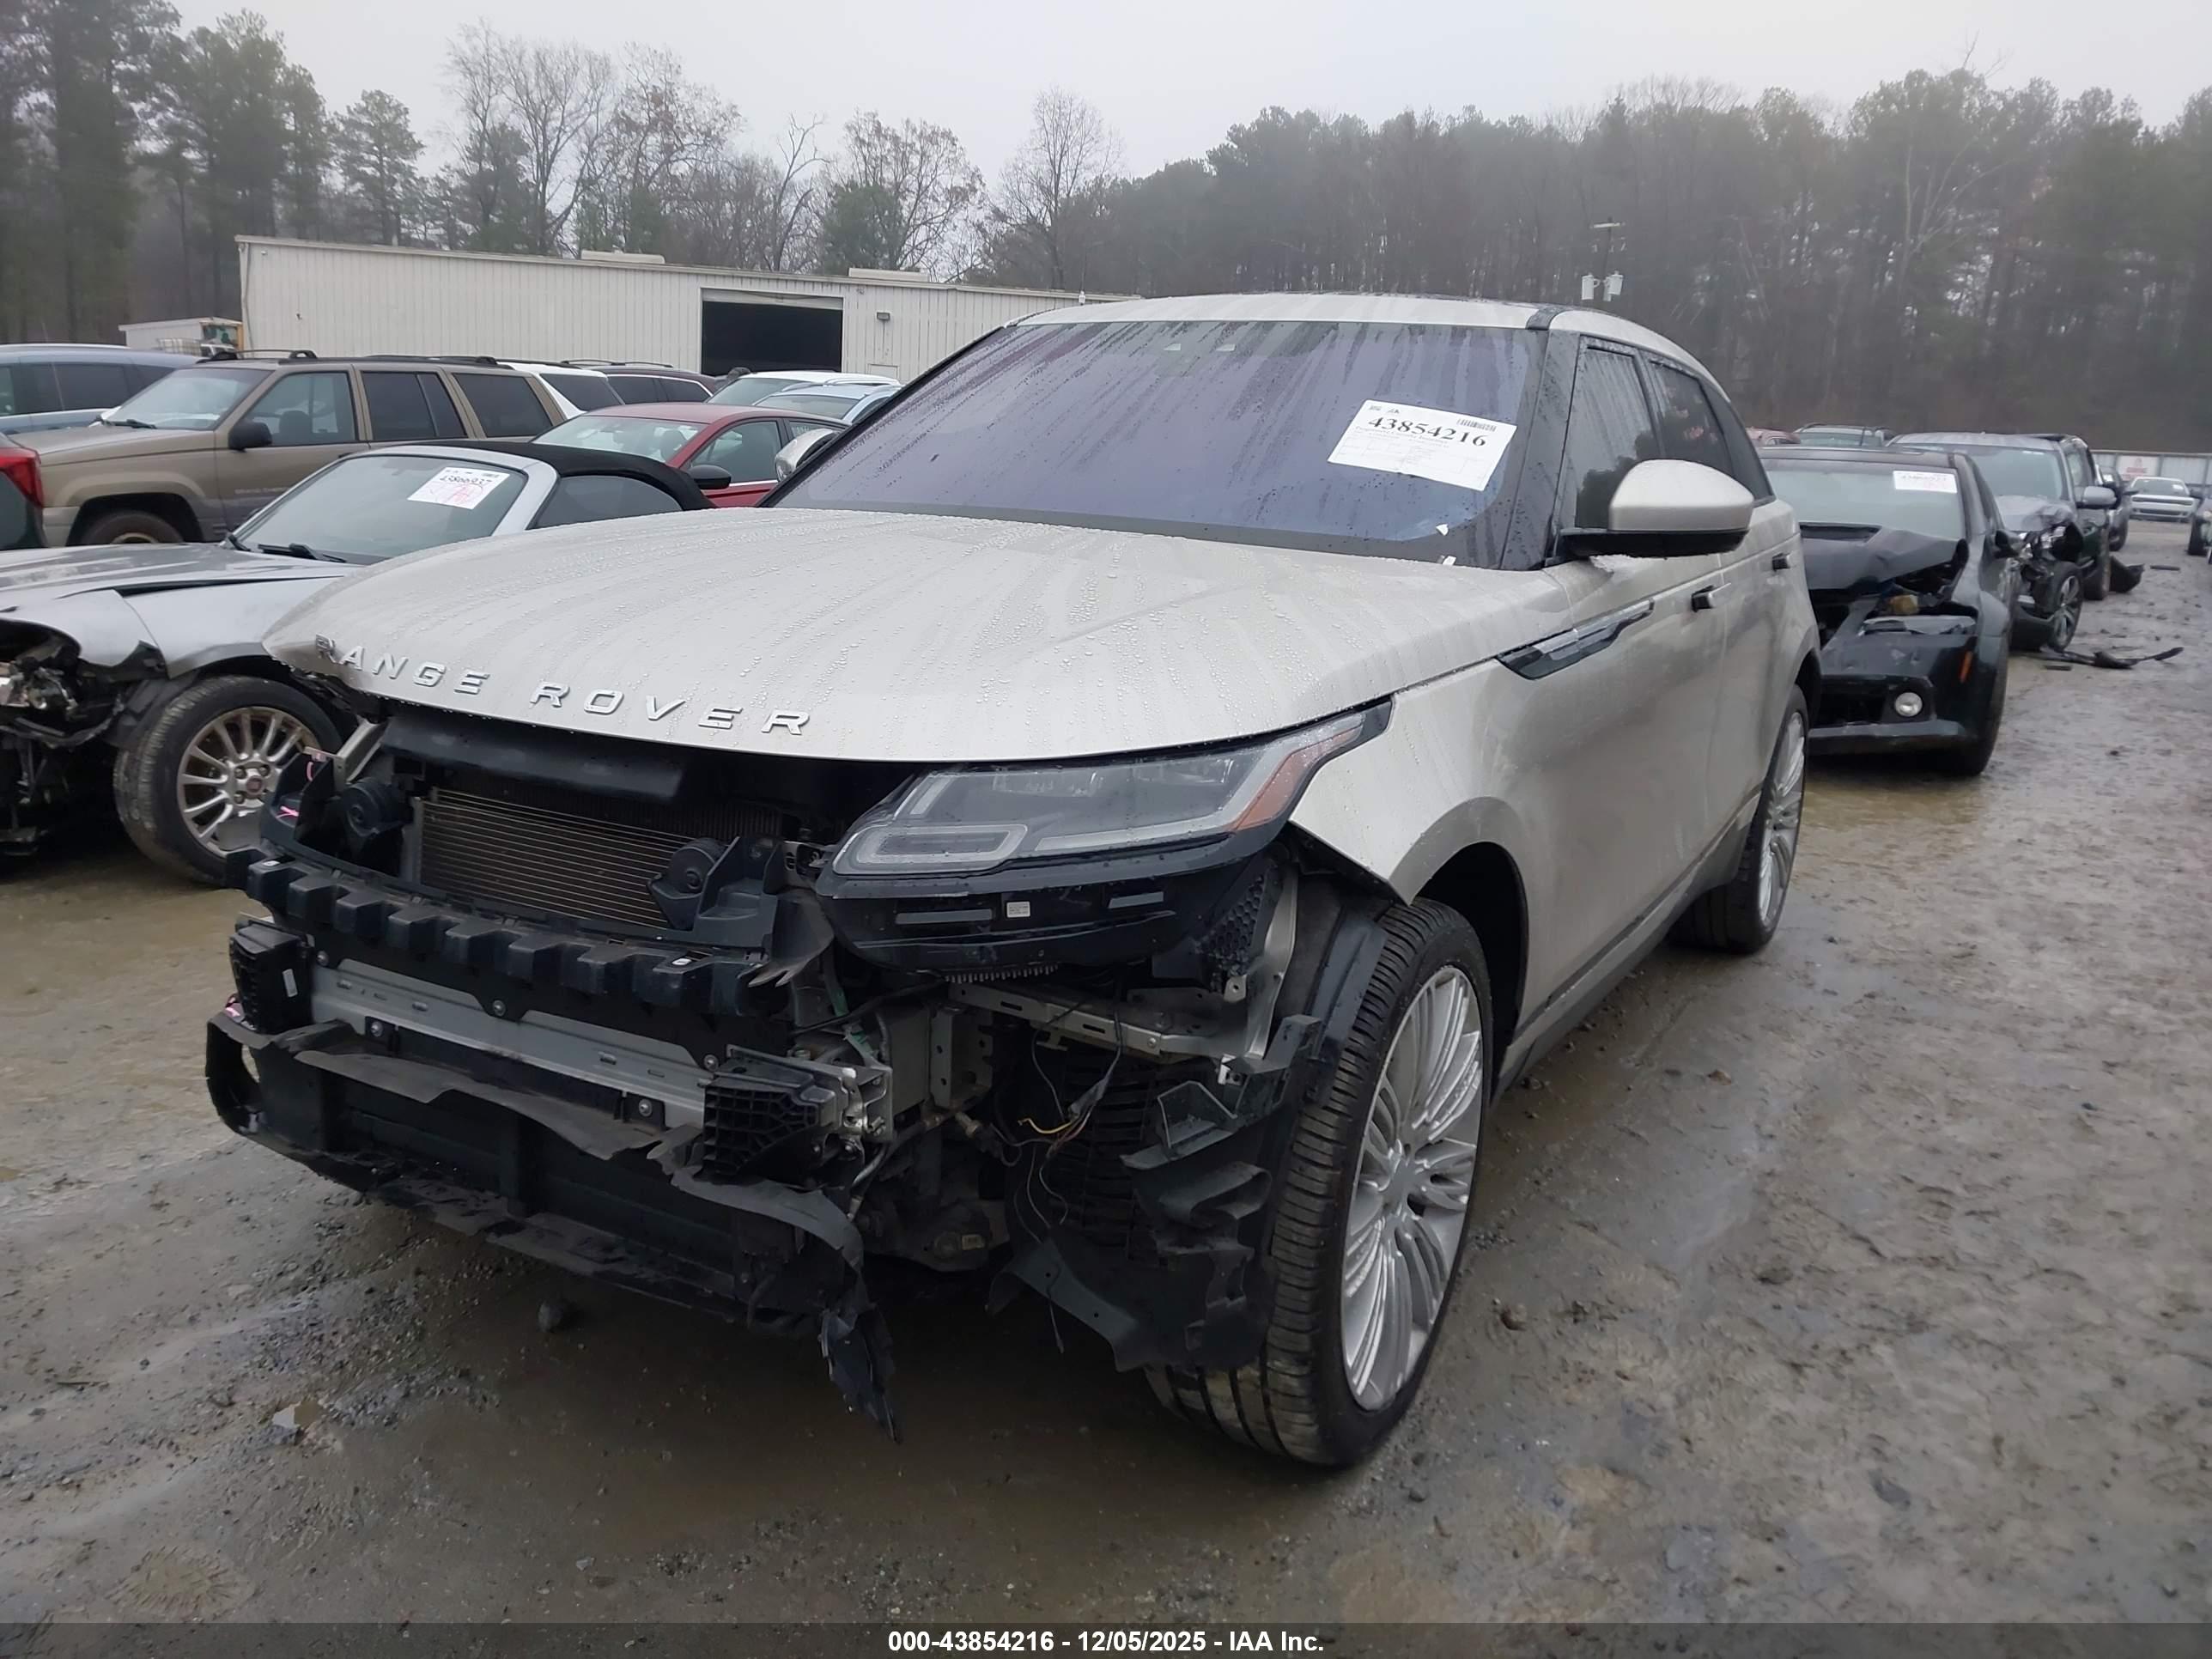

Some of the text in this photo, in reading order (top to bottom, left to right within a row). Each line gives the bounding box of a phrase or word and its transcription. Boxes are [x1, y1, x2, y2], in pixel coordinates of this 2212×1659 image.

[1368, 416, 1487, 447] 43854216
[314, 634, 811, 736] RANGE ROVER
